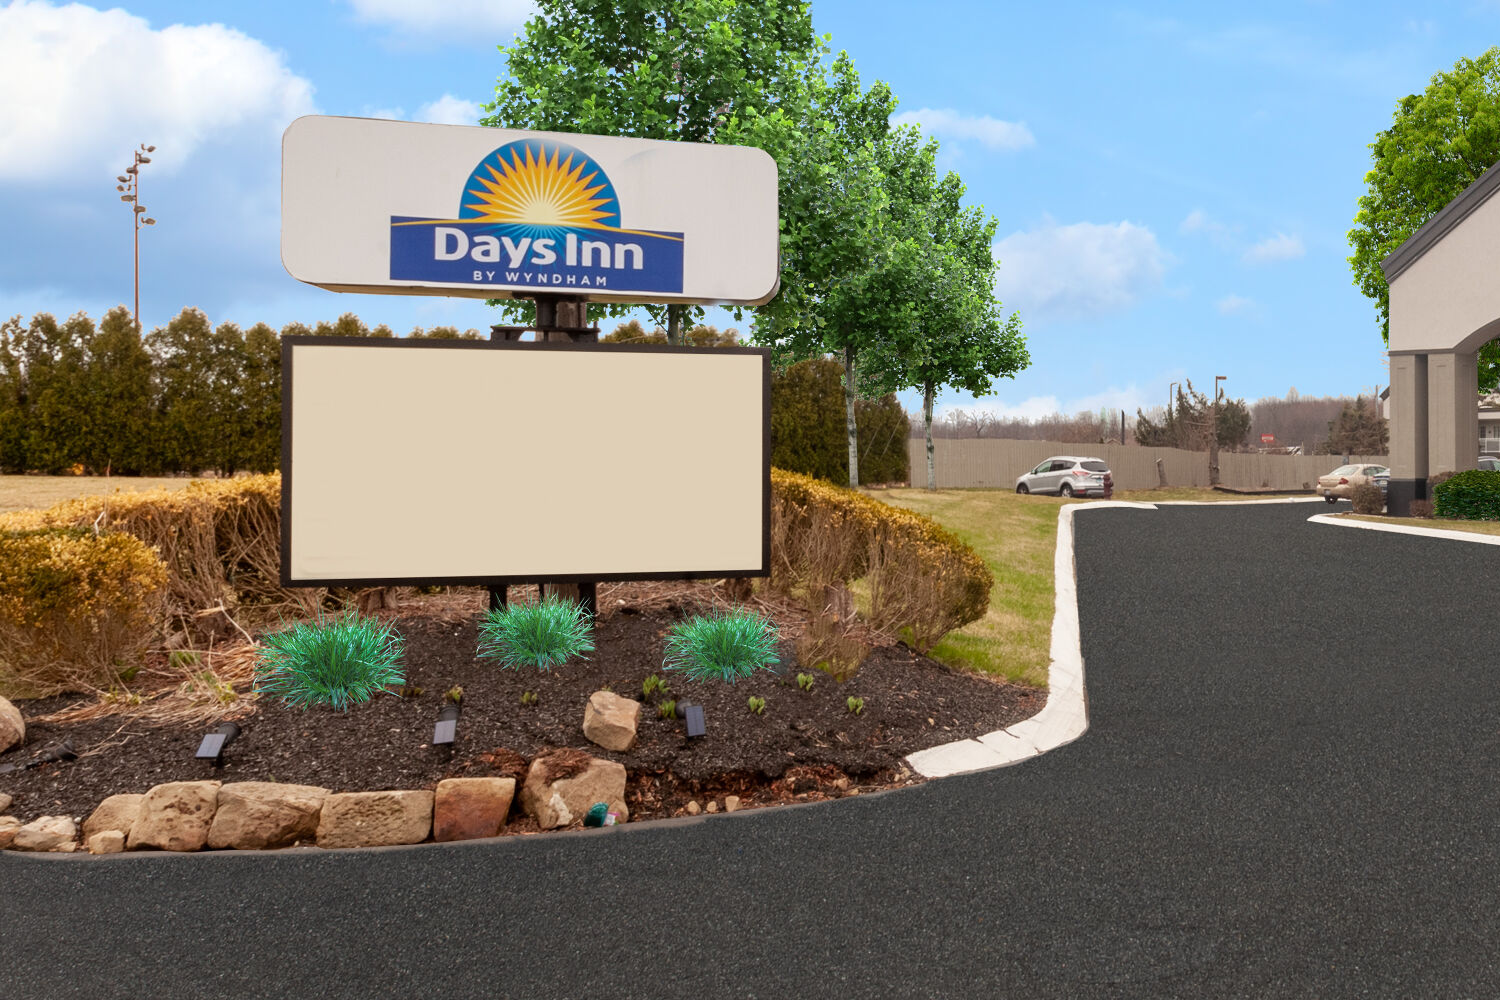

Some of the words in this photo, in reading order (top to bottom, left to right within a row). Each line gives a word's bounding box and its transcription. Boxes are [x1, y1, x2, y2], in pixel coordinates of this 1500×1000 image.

[434, 226, 557, 269] Days
[565, 233, 644, 270] Inn
[473, 270, 496, 281] BY
[505, 272, 607, 287] WYNDHAM
